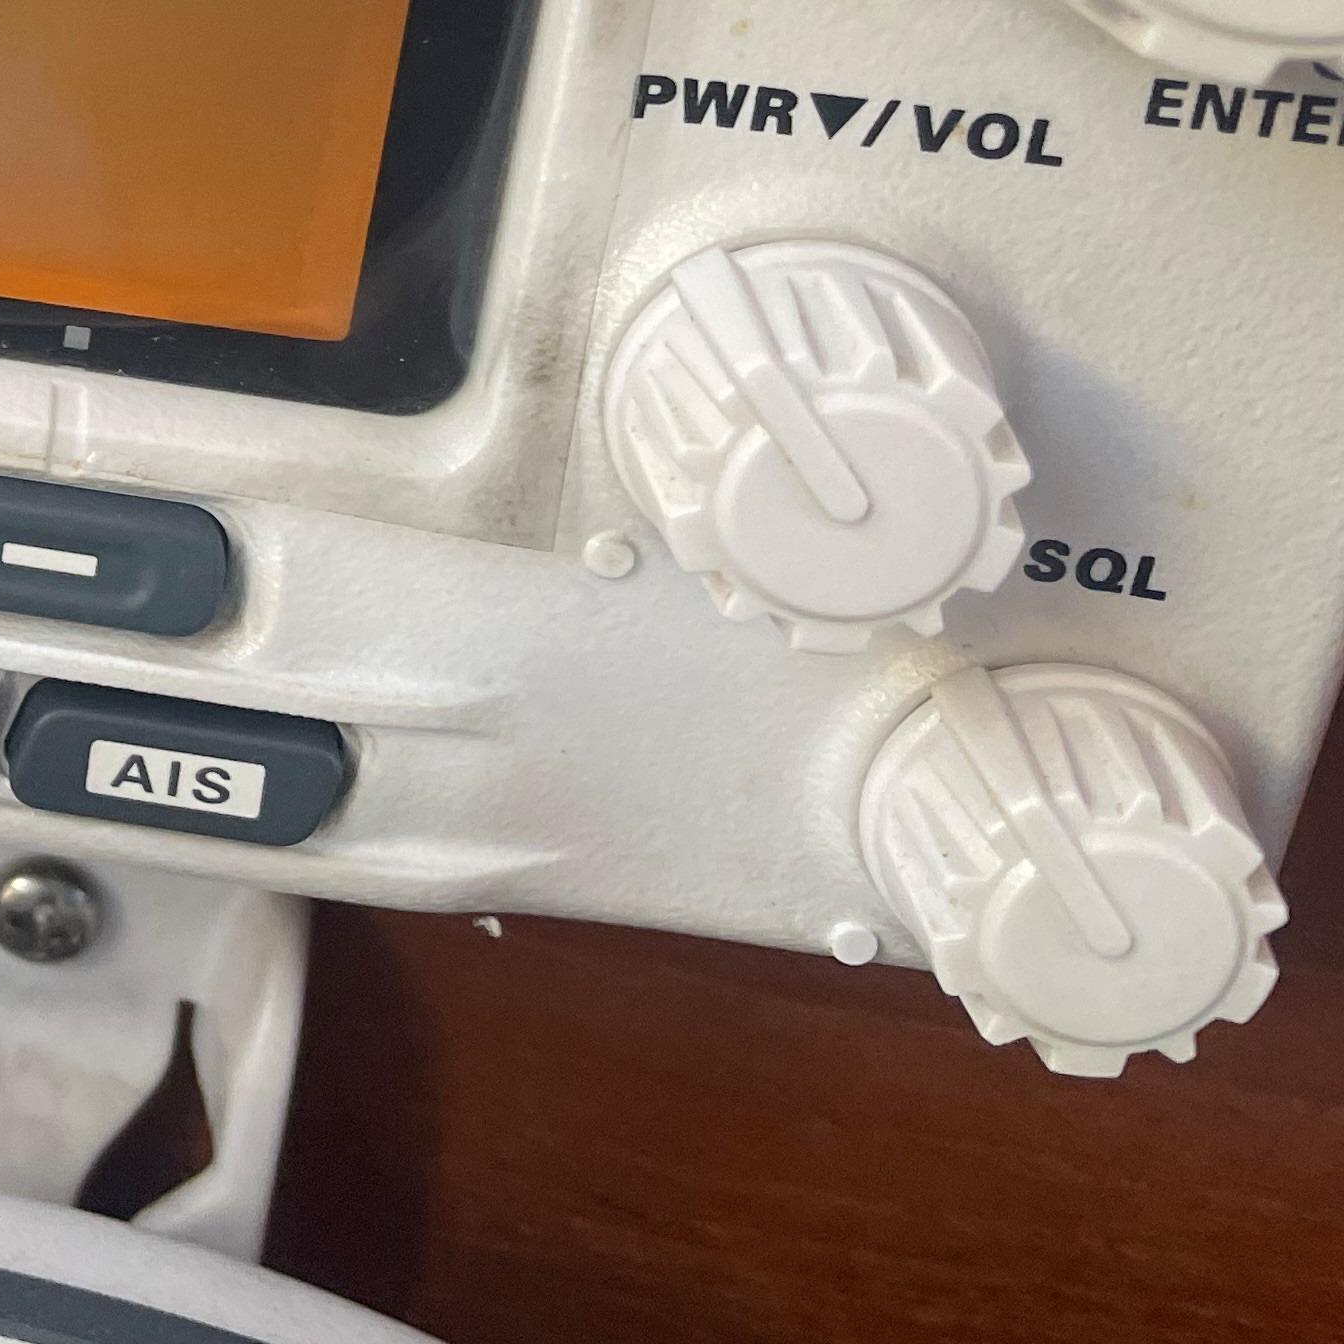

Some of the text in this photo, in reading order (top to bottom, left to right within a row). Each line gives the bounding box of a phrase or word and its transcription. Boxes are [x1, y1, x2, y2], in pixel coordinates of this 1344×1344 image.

[1143, 78, 1344, 148] ENTE
[1023, 538, 1168, 602] SQL
[110, 752, 233, 806] AIS
